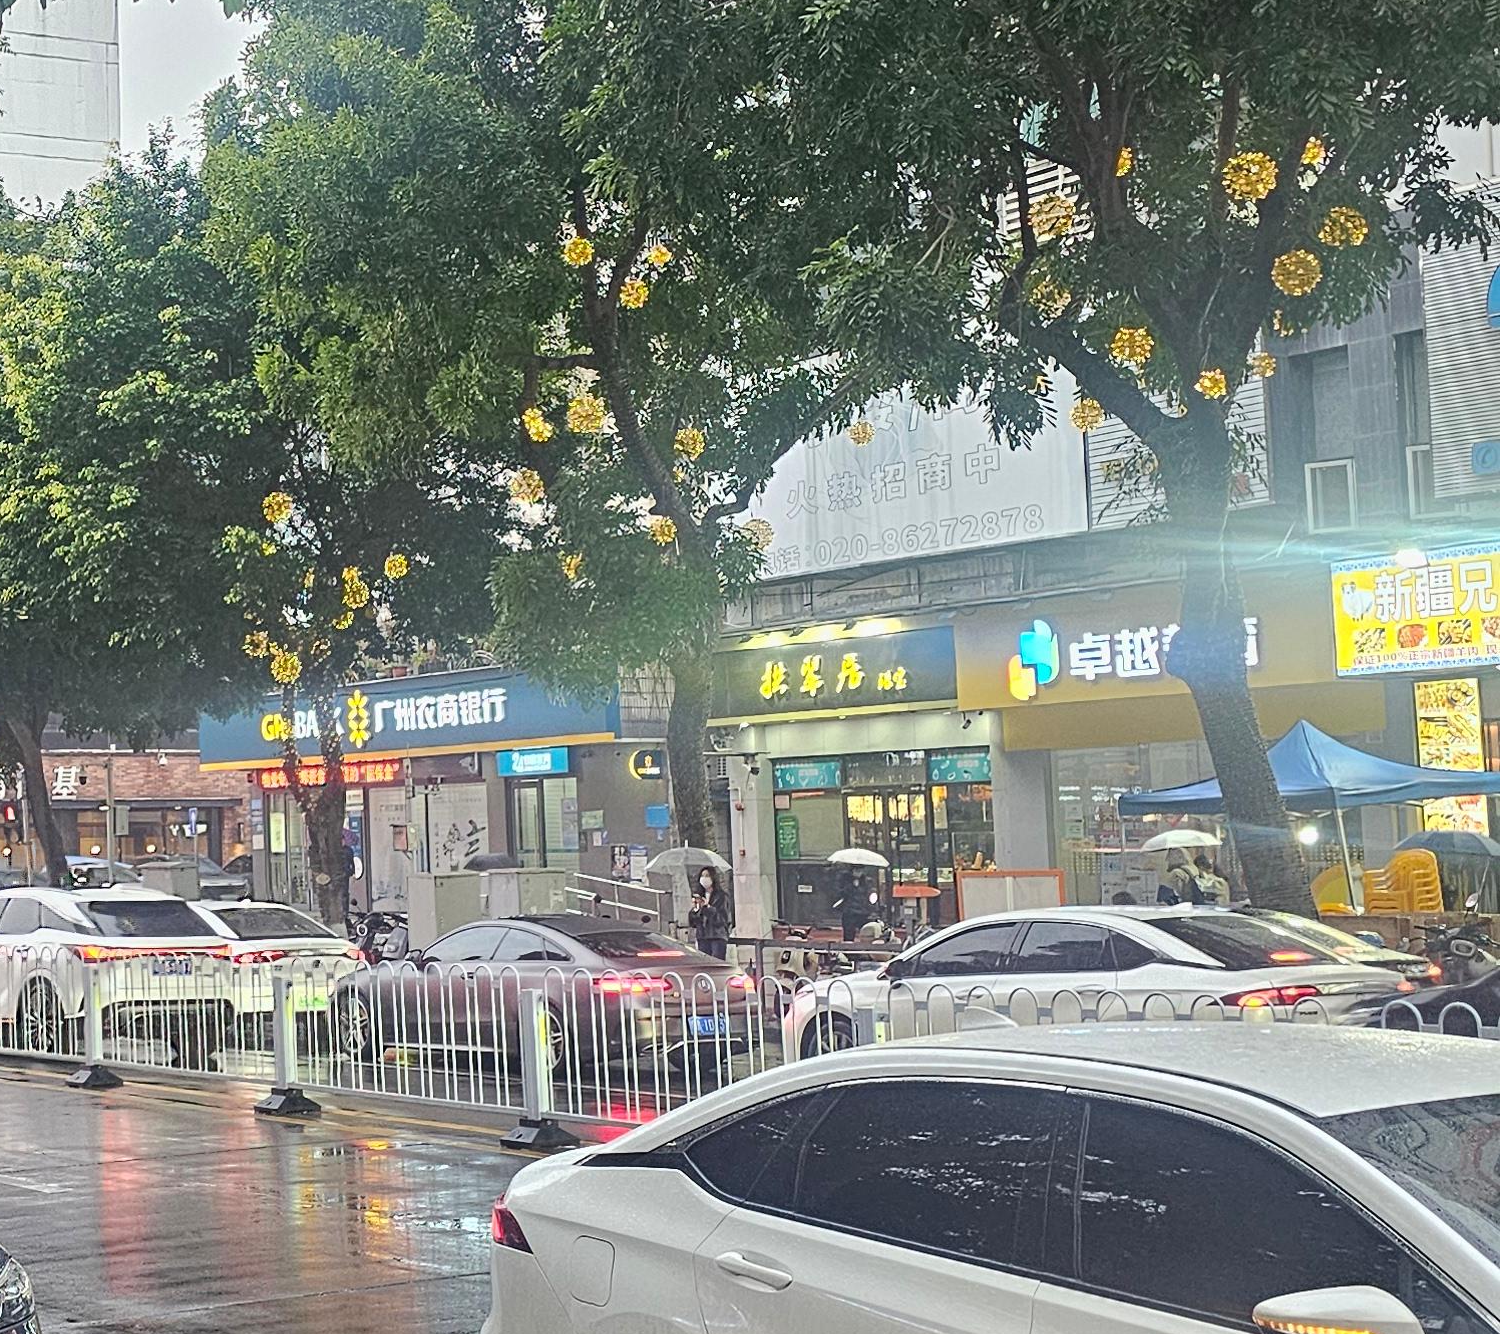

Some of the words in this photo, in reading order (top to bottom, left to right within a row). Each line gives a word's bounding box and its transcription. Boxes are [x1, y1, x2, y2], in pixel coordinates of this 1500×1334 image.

[786, 444, 1001, 519] 火热招商中
[1374, 560, 1498, 624] 新疆兄
[374, 687, 508, 733] 广州农商银行
